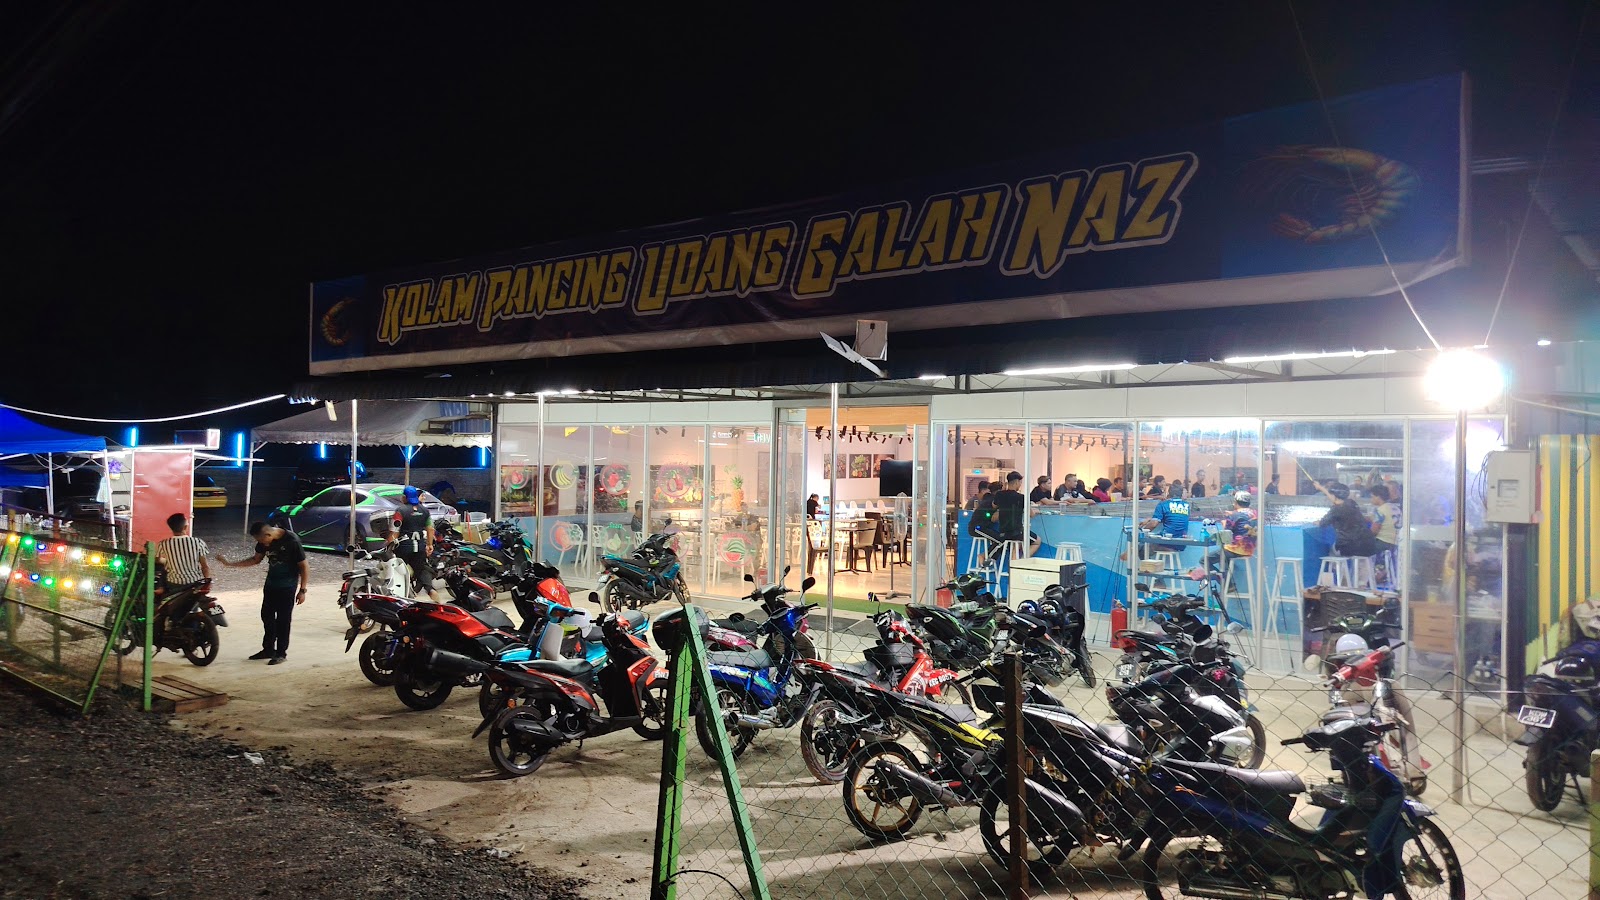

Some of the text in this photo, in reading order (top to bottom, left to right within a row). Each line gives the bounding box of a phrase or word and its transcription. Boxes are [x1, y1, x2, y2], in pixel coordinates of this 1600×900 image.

[376, 153, 1197, 344] KOLAM PANCING UDANG GALAH NAZ
